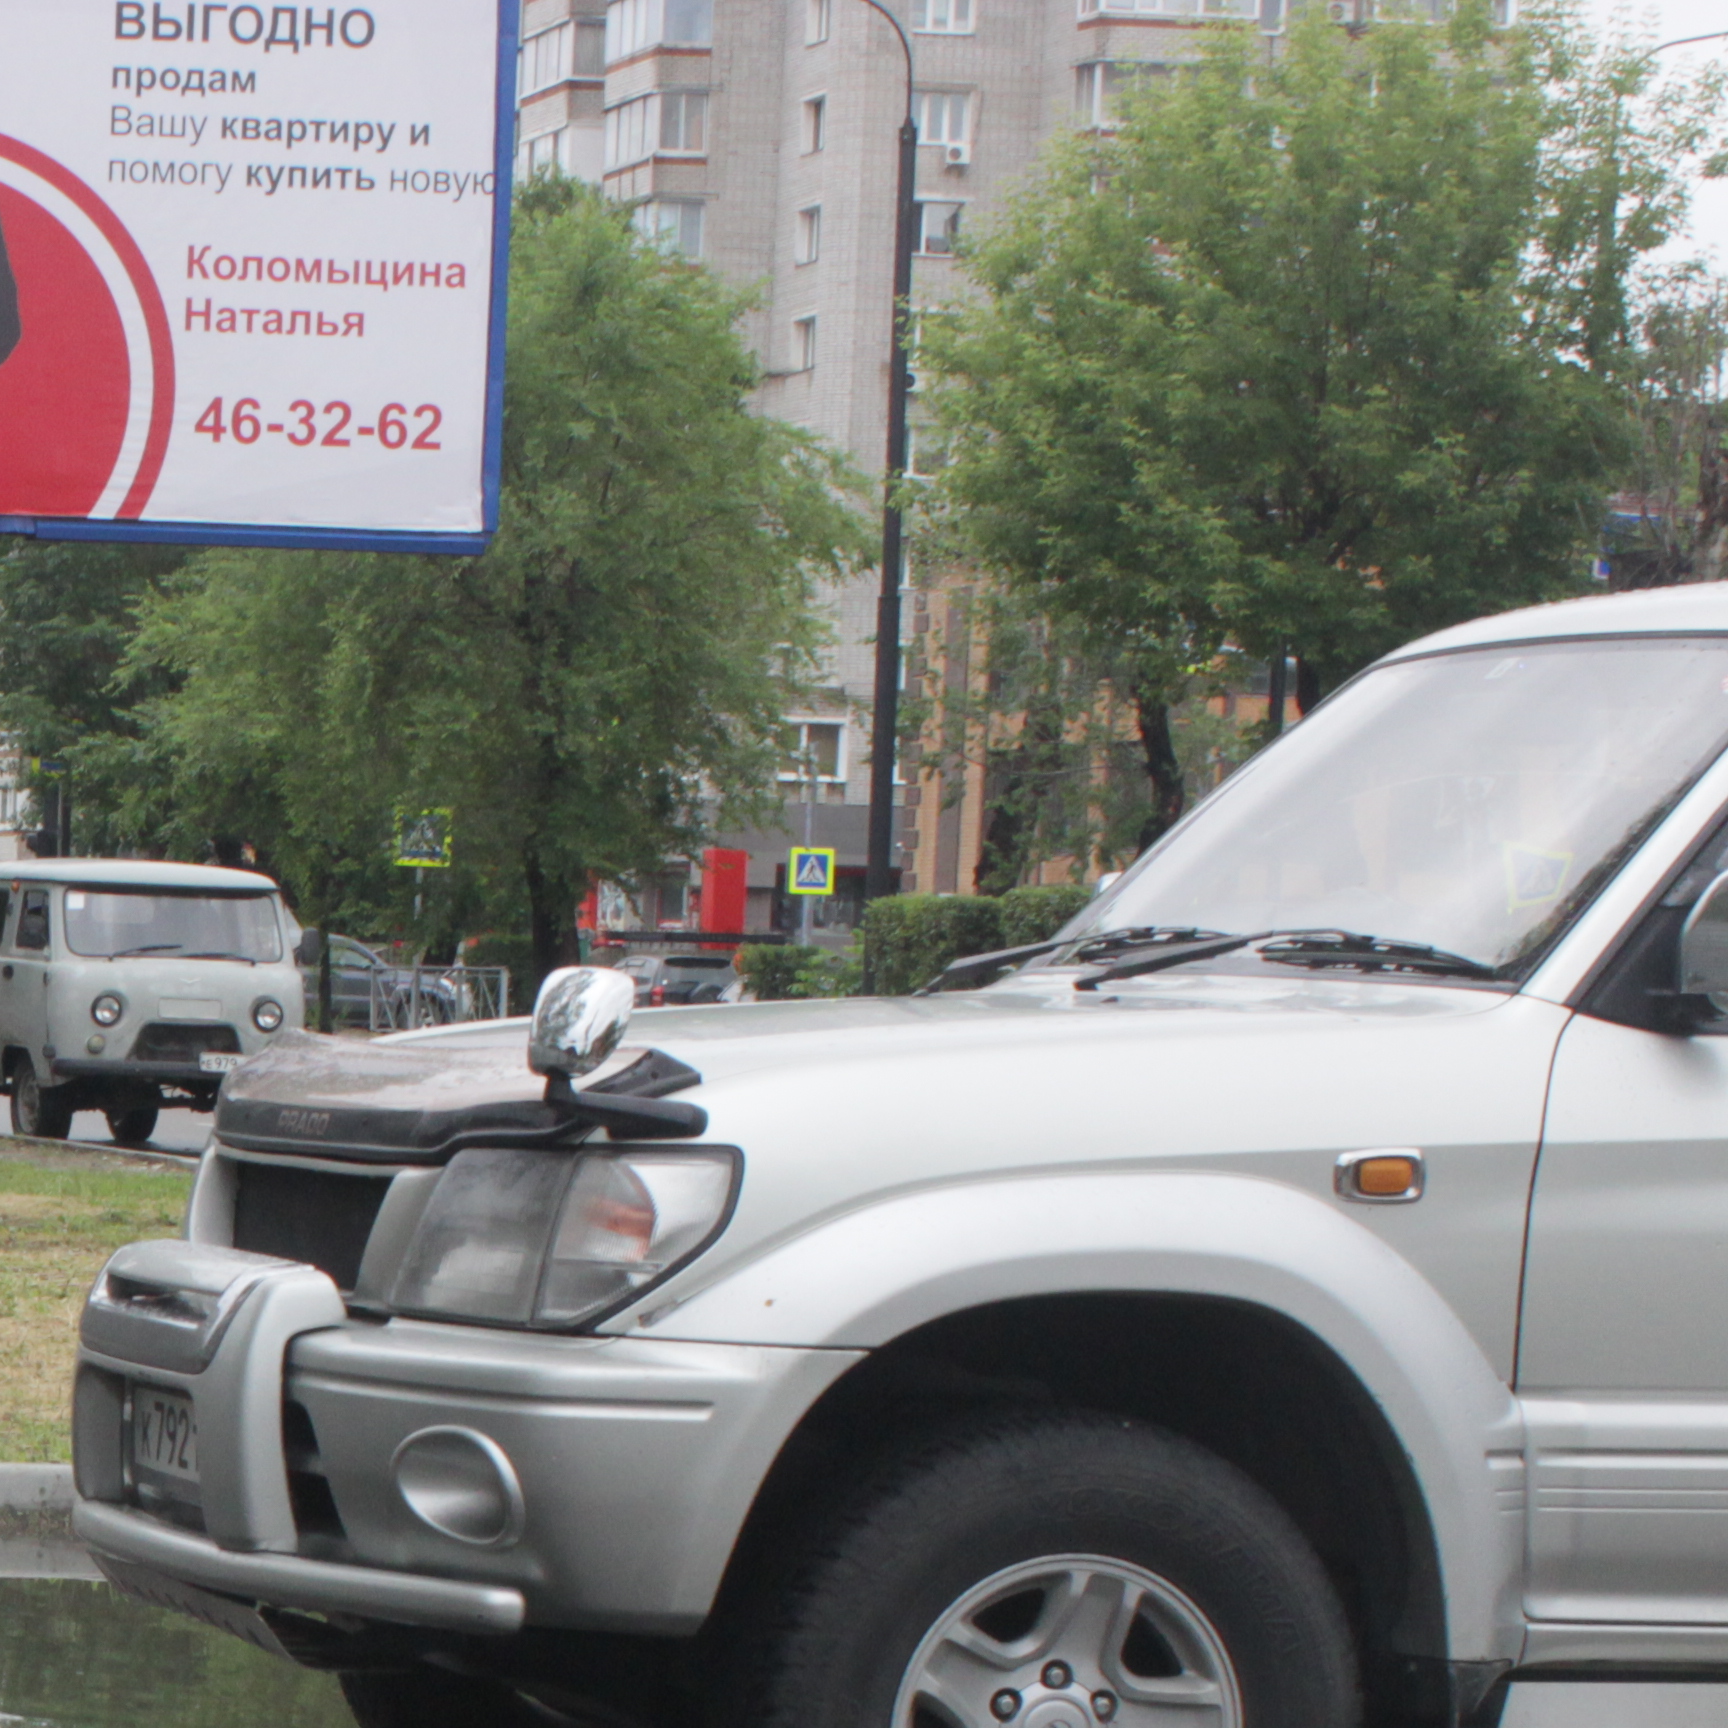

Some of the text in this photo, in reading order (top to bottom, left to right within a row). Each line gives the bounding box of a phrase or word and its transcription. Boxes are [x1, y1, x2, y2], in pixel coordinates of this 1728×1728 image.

[114, 1, 376, 54] ВЫГОДНО
[111, 65, 257, 98] продам
[110, 105, 430, 153] Вашу квартиру и
[107, 159, 495, 203] помогу купить новую
[186, 245, 467, 292] Коломыцина
[184, 297, 365, 337] Наталья
[194, 396, 443, 451] 46-32-62
[278, 1109, 330, 1136] PRADO
[141, 1400, 197, 1470] К792
